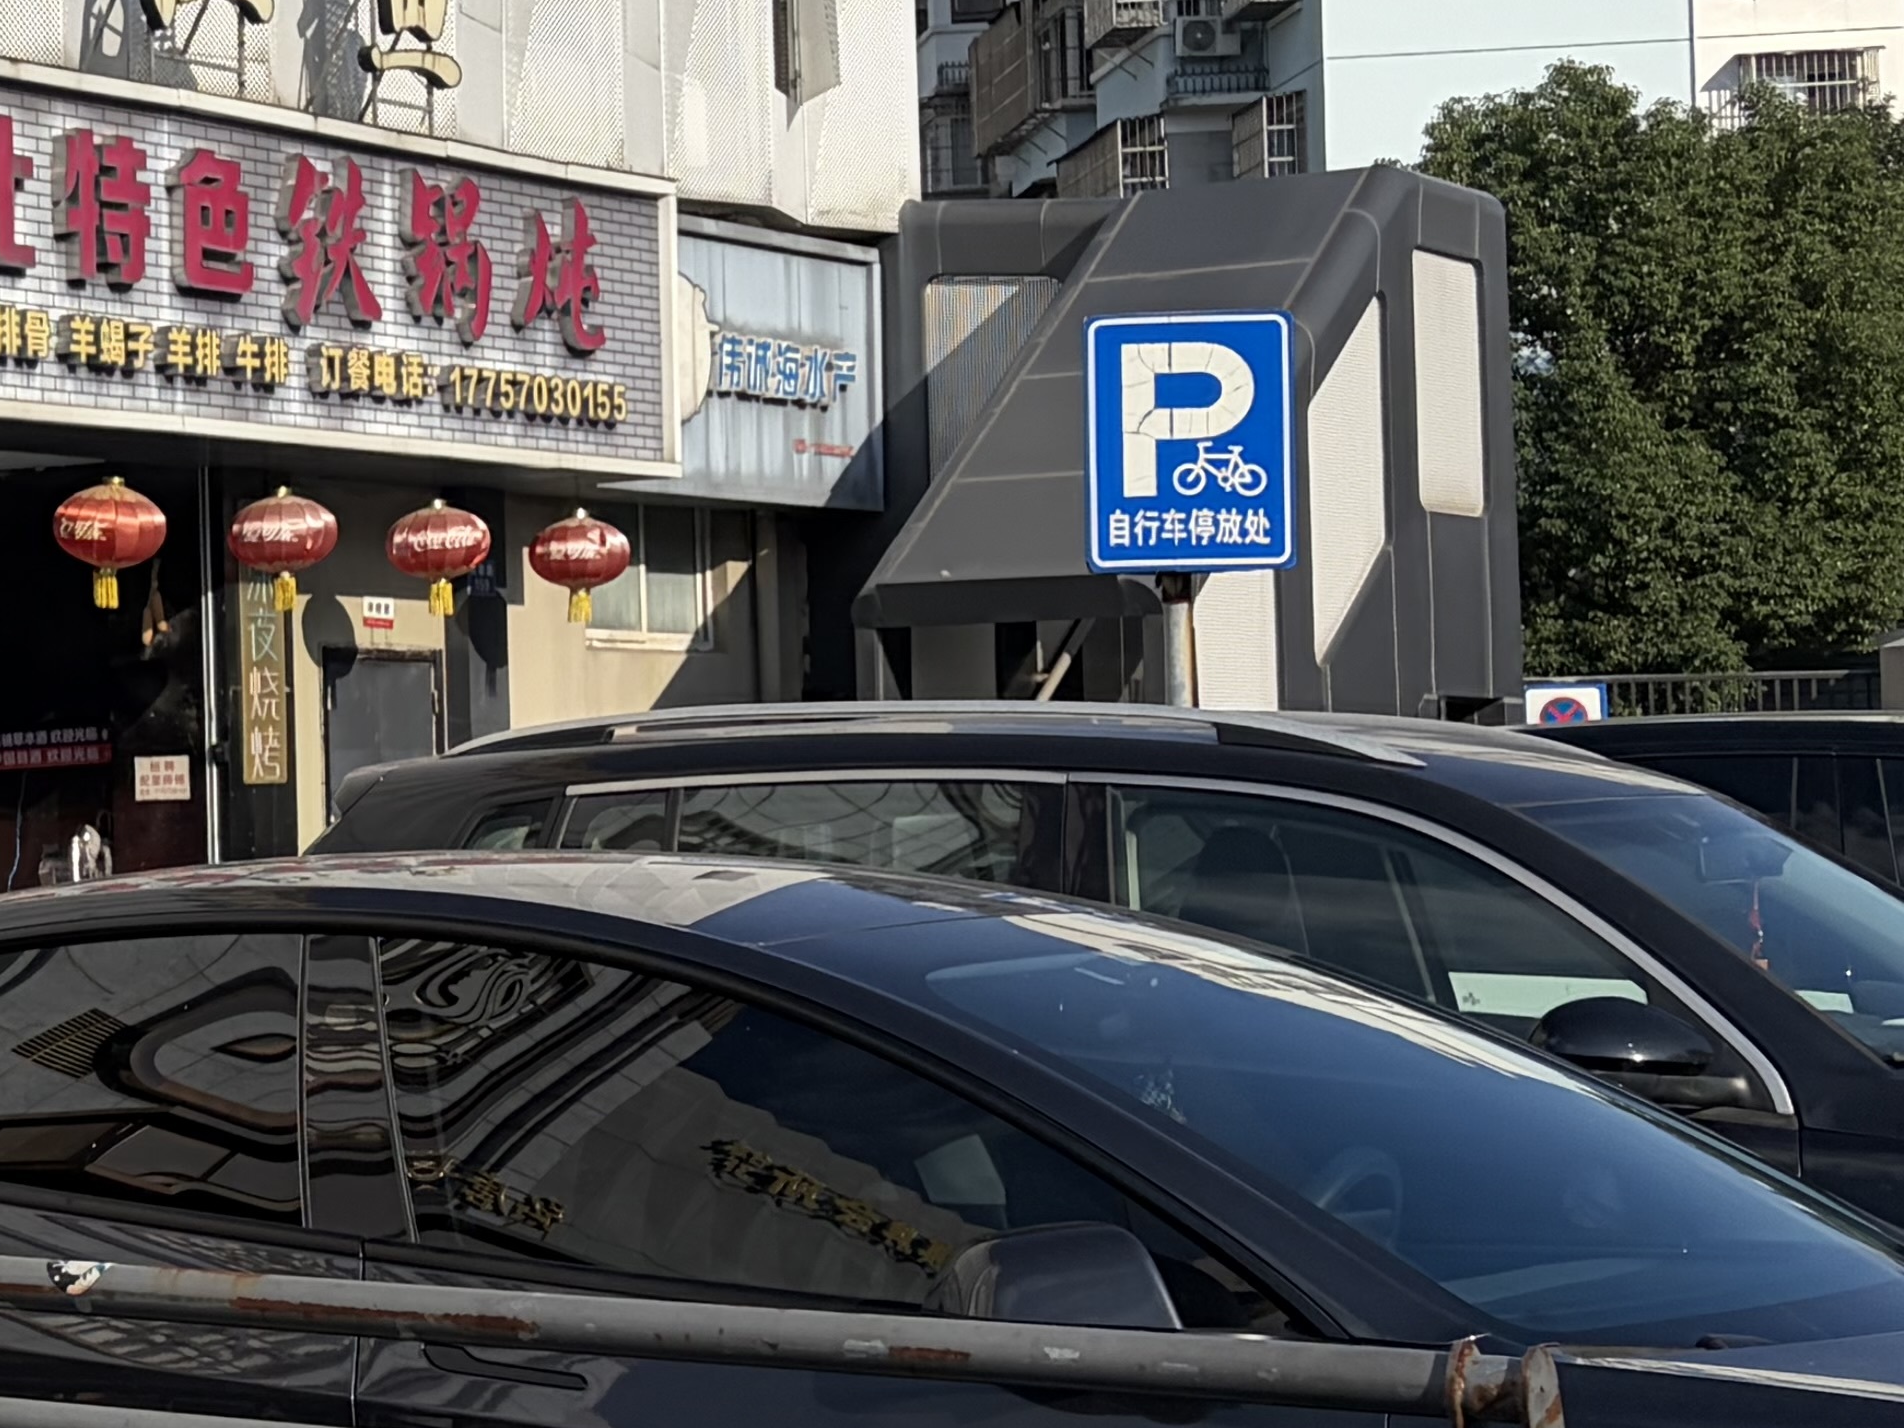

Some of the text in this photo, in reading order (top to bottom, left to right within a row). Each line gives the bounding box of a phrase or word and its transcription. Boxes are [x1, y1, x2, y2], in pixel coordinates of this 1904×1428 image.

[1121, 341, 1255, 498] P
[1109, 507, 1272, 547] 自行车停放处
